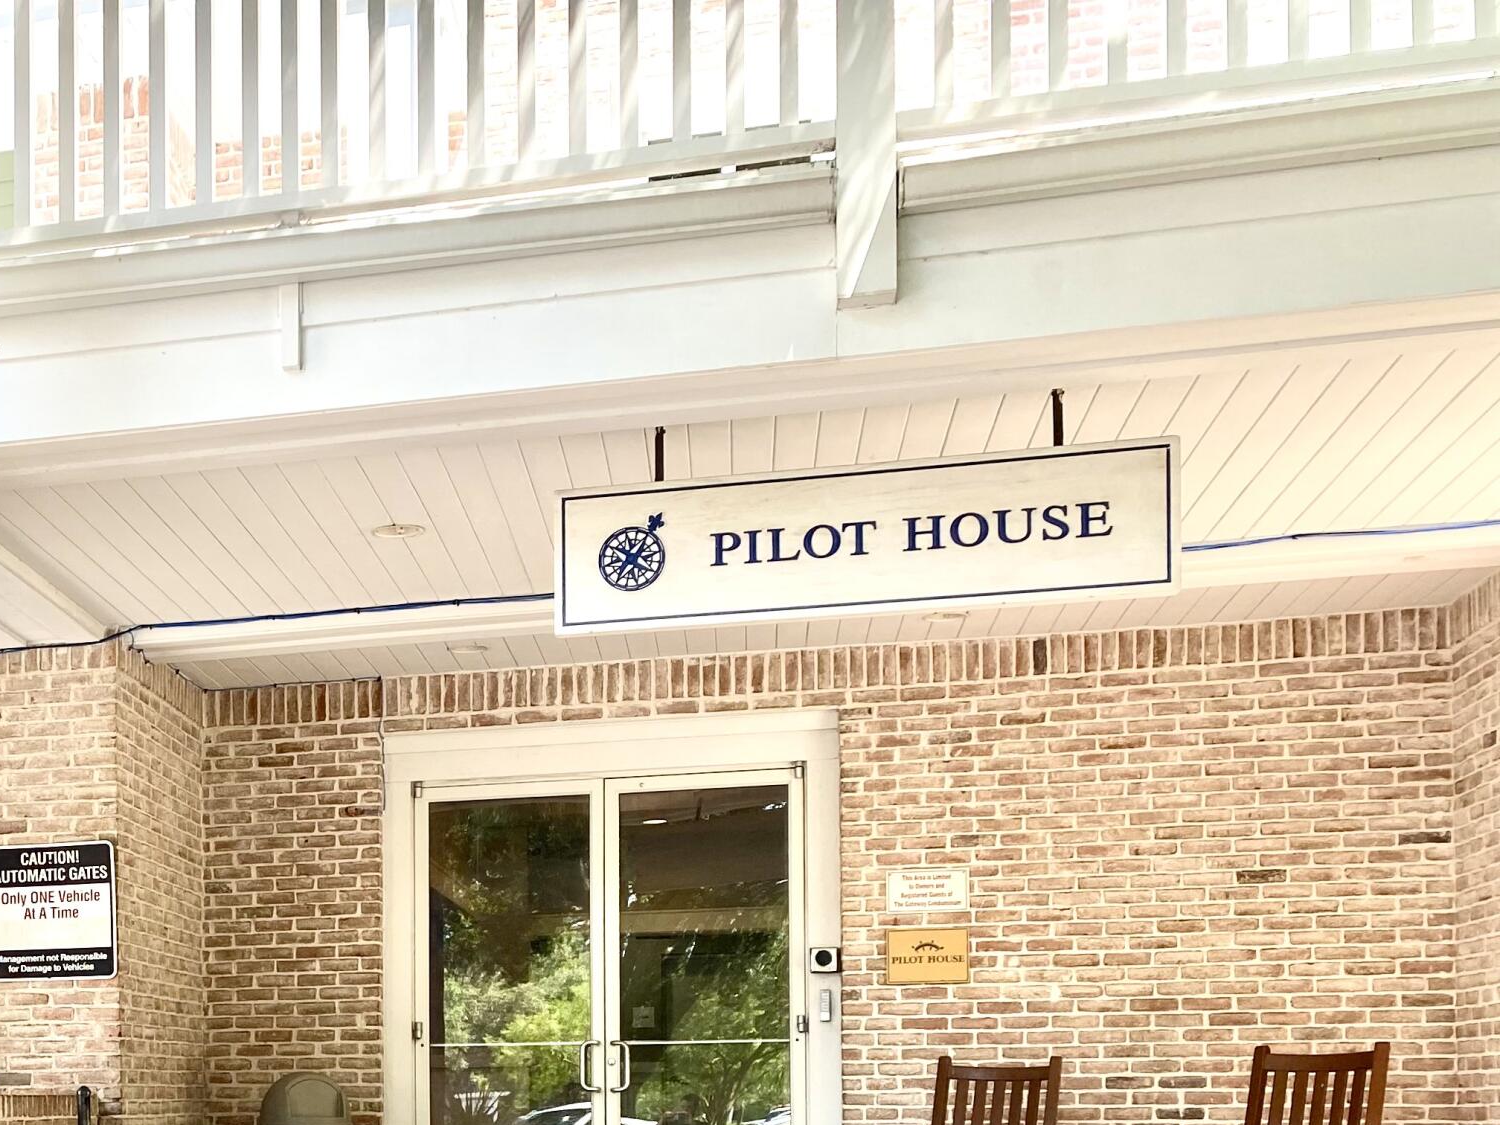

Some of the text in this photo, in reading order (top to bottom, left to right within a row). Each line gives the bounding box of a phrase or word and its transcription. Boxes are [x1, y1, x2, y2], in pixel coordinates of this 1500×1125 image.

[709, 500, 1113, 567] PILOT HOUSE
[20, 849, 80, 866] CAUTION!
[69, 865, 108, 880] GATES
[1, 889, 100, 906] Only ONE Vehicle
[24, 906, 79, 920] At A Time
[61, 952, 107, 962] Responsible
[892, 955, 965, 964] PILOT HOUSE
[8, 965, 19, 973] for
[21, 964, 52, 973] Damage
[63, 962, 94, 970] Vehicles
